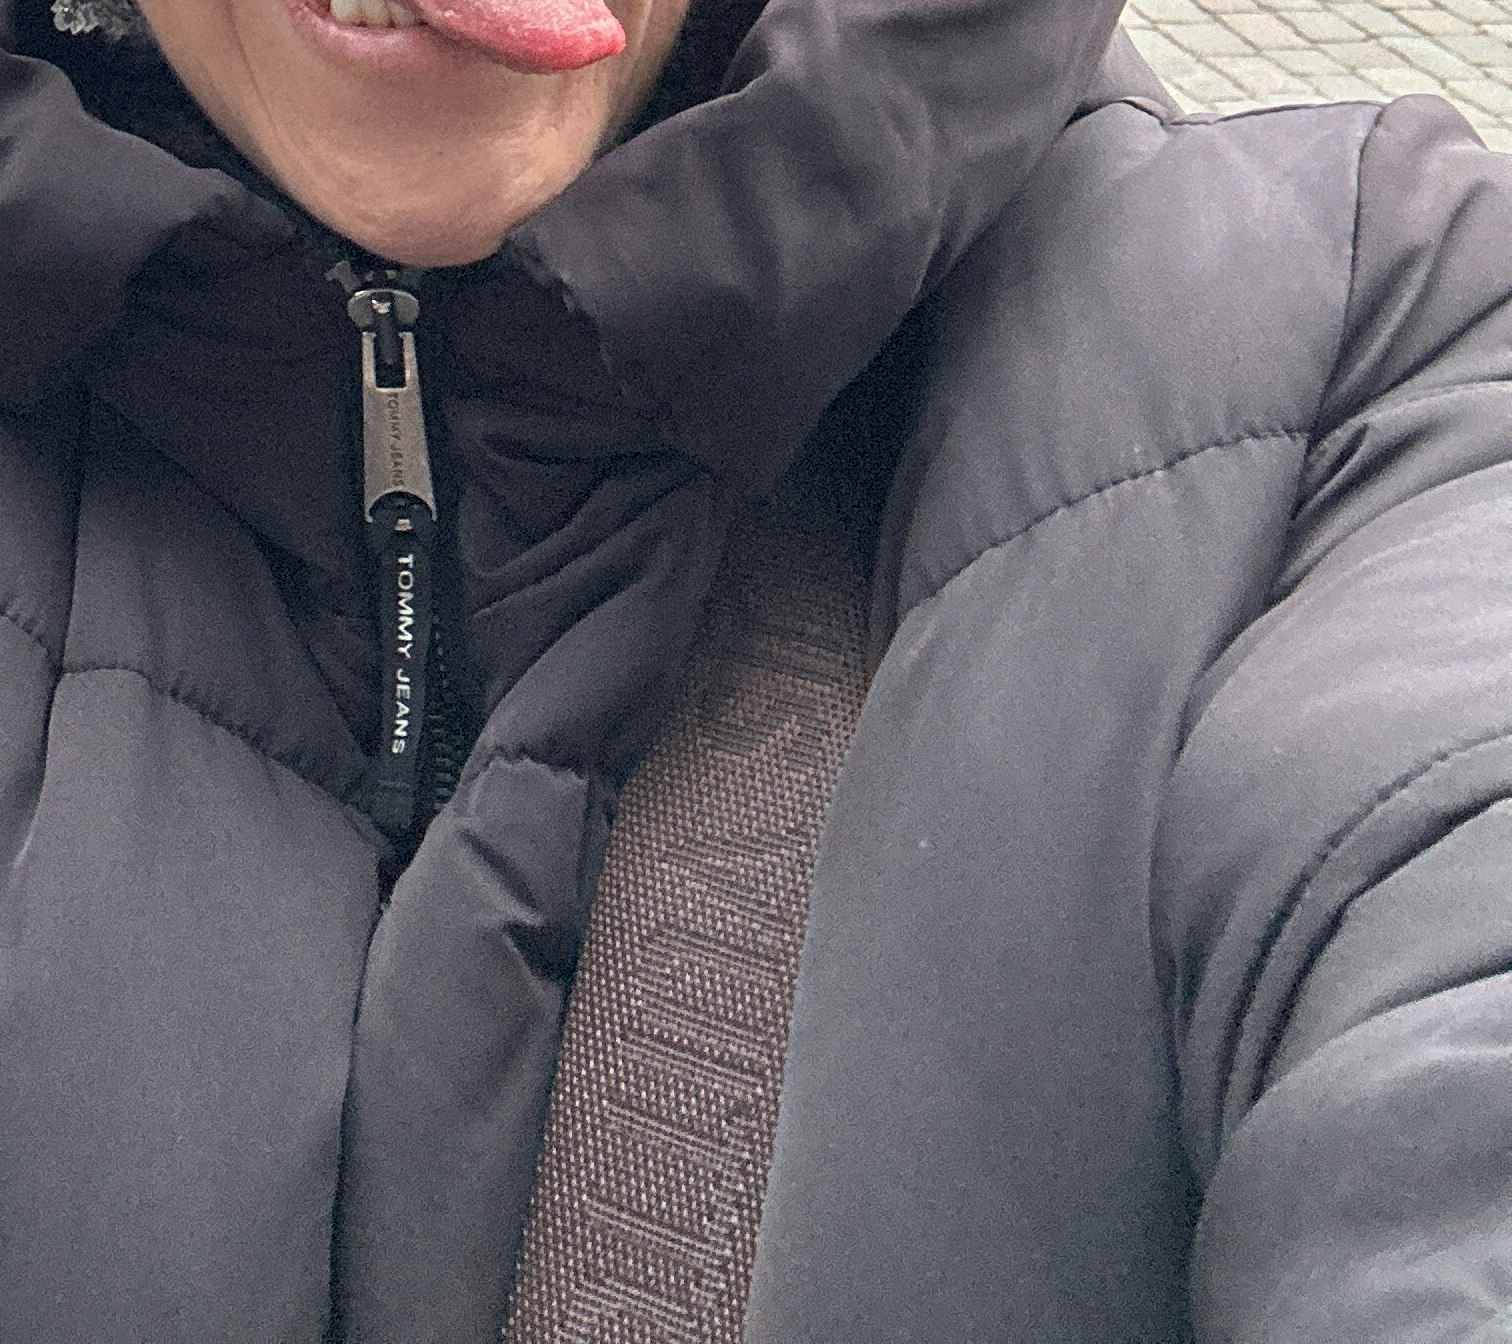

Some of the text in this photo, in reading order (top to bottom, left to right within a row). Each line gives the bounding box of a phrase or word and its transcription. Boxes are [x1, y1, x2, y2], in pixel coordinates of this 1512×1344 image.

[388, 392, 405, 487] TOMMY JEANS
[391, 553, 415, 755] TOMMY JEANS
